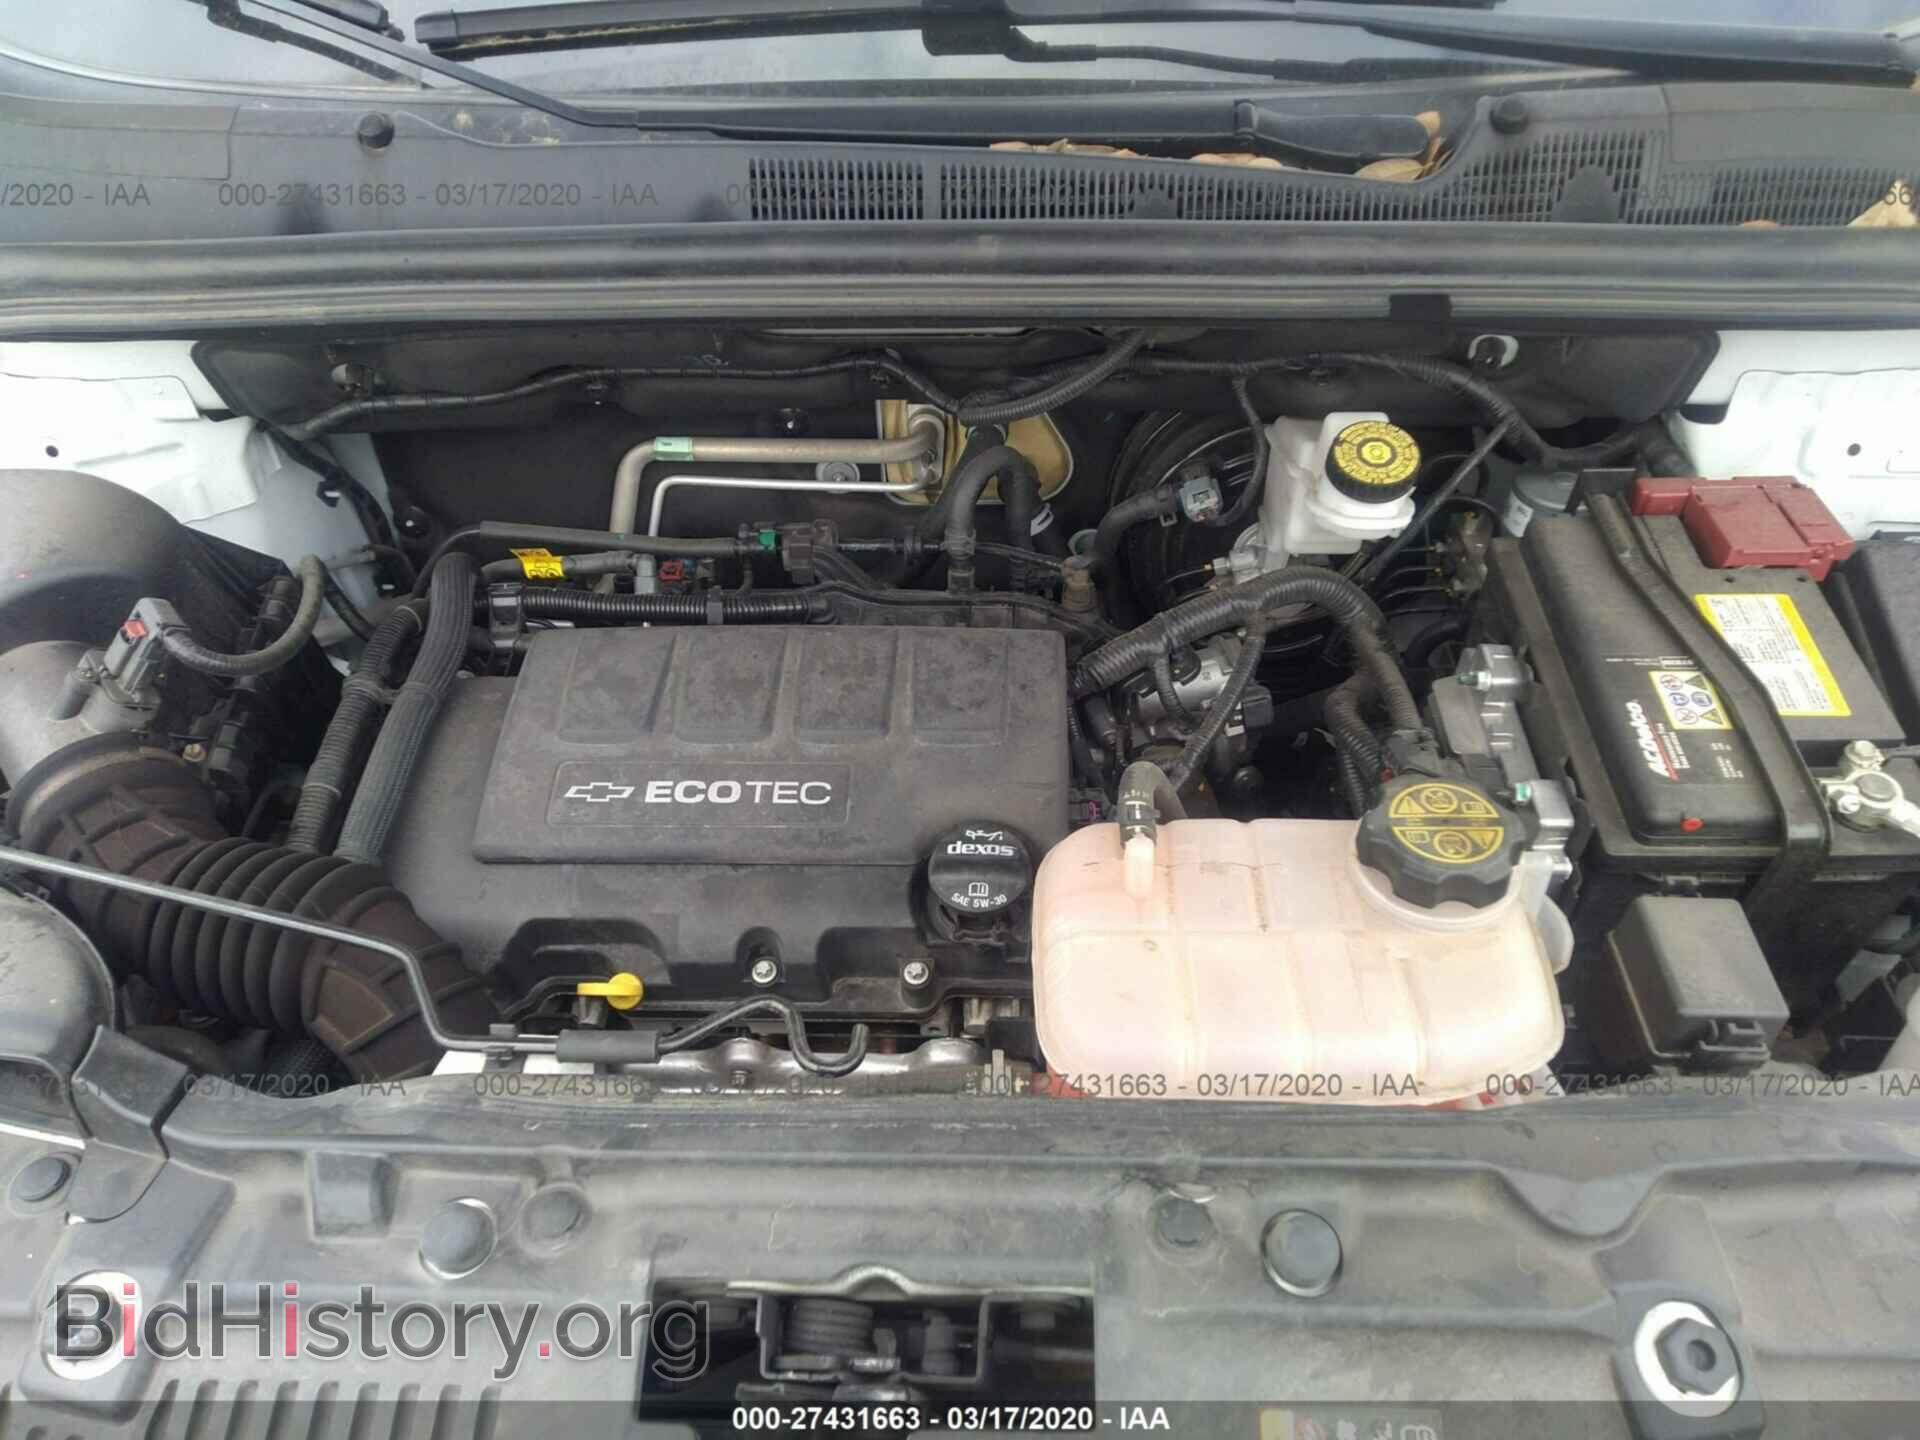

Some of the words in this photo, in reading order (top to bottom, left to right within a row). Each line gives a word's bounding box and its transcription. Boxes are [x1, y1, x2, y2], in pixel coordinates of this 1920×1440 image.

[645, 780, 832, 805] ECOTEC
[946, 840, 1018, 857] dexos
[951, 892, 970, 908] SAE
[972, 894, 1008, 909] 5W-30
